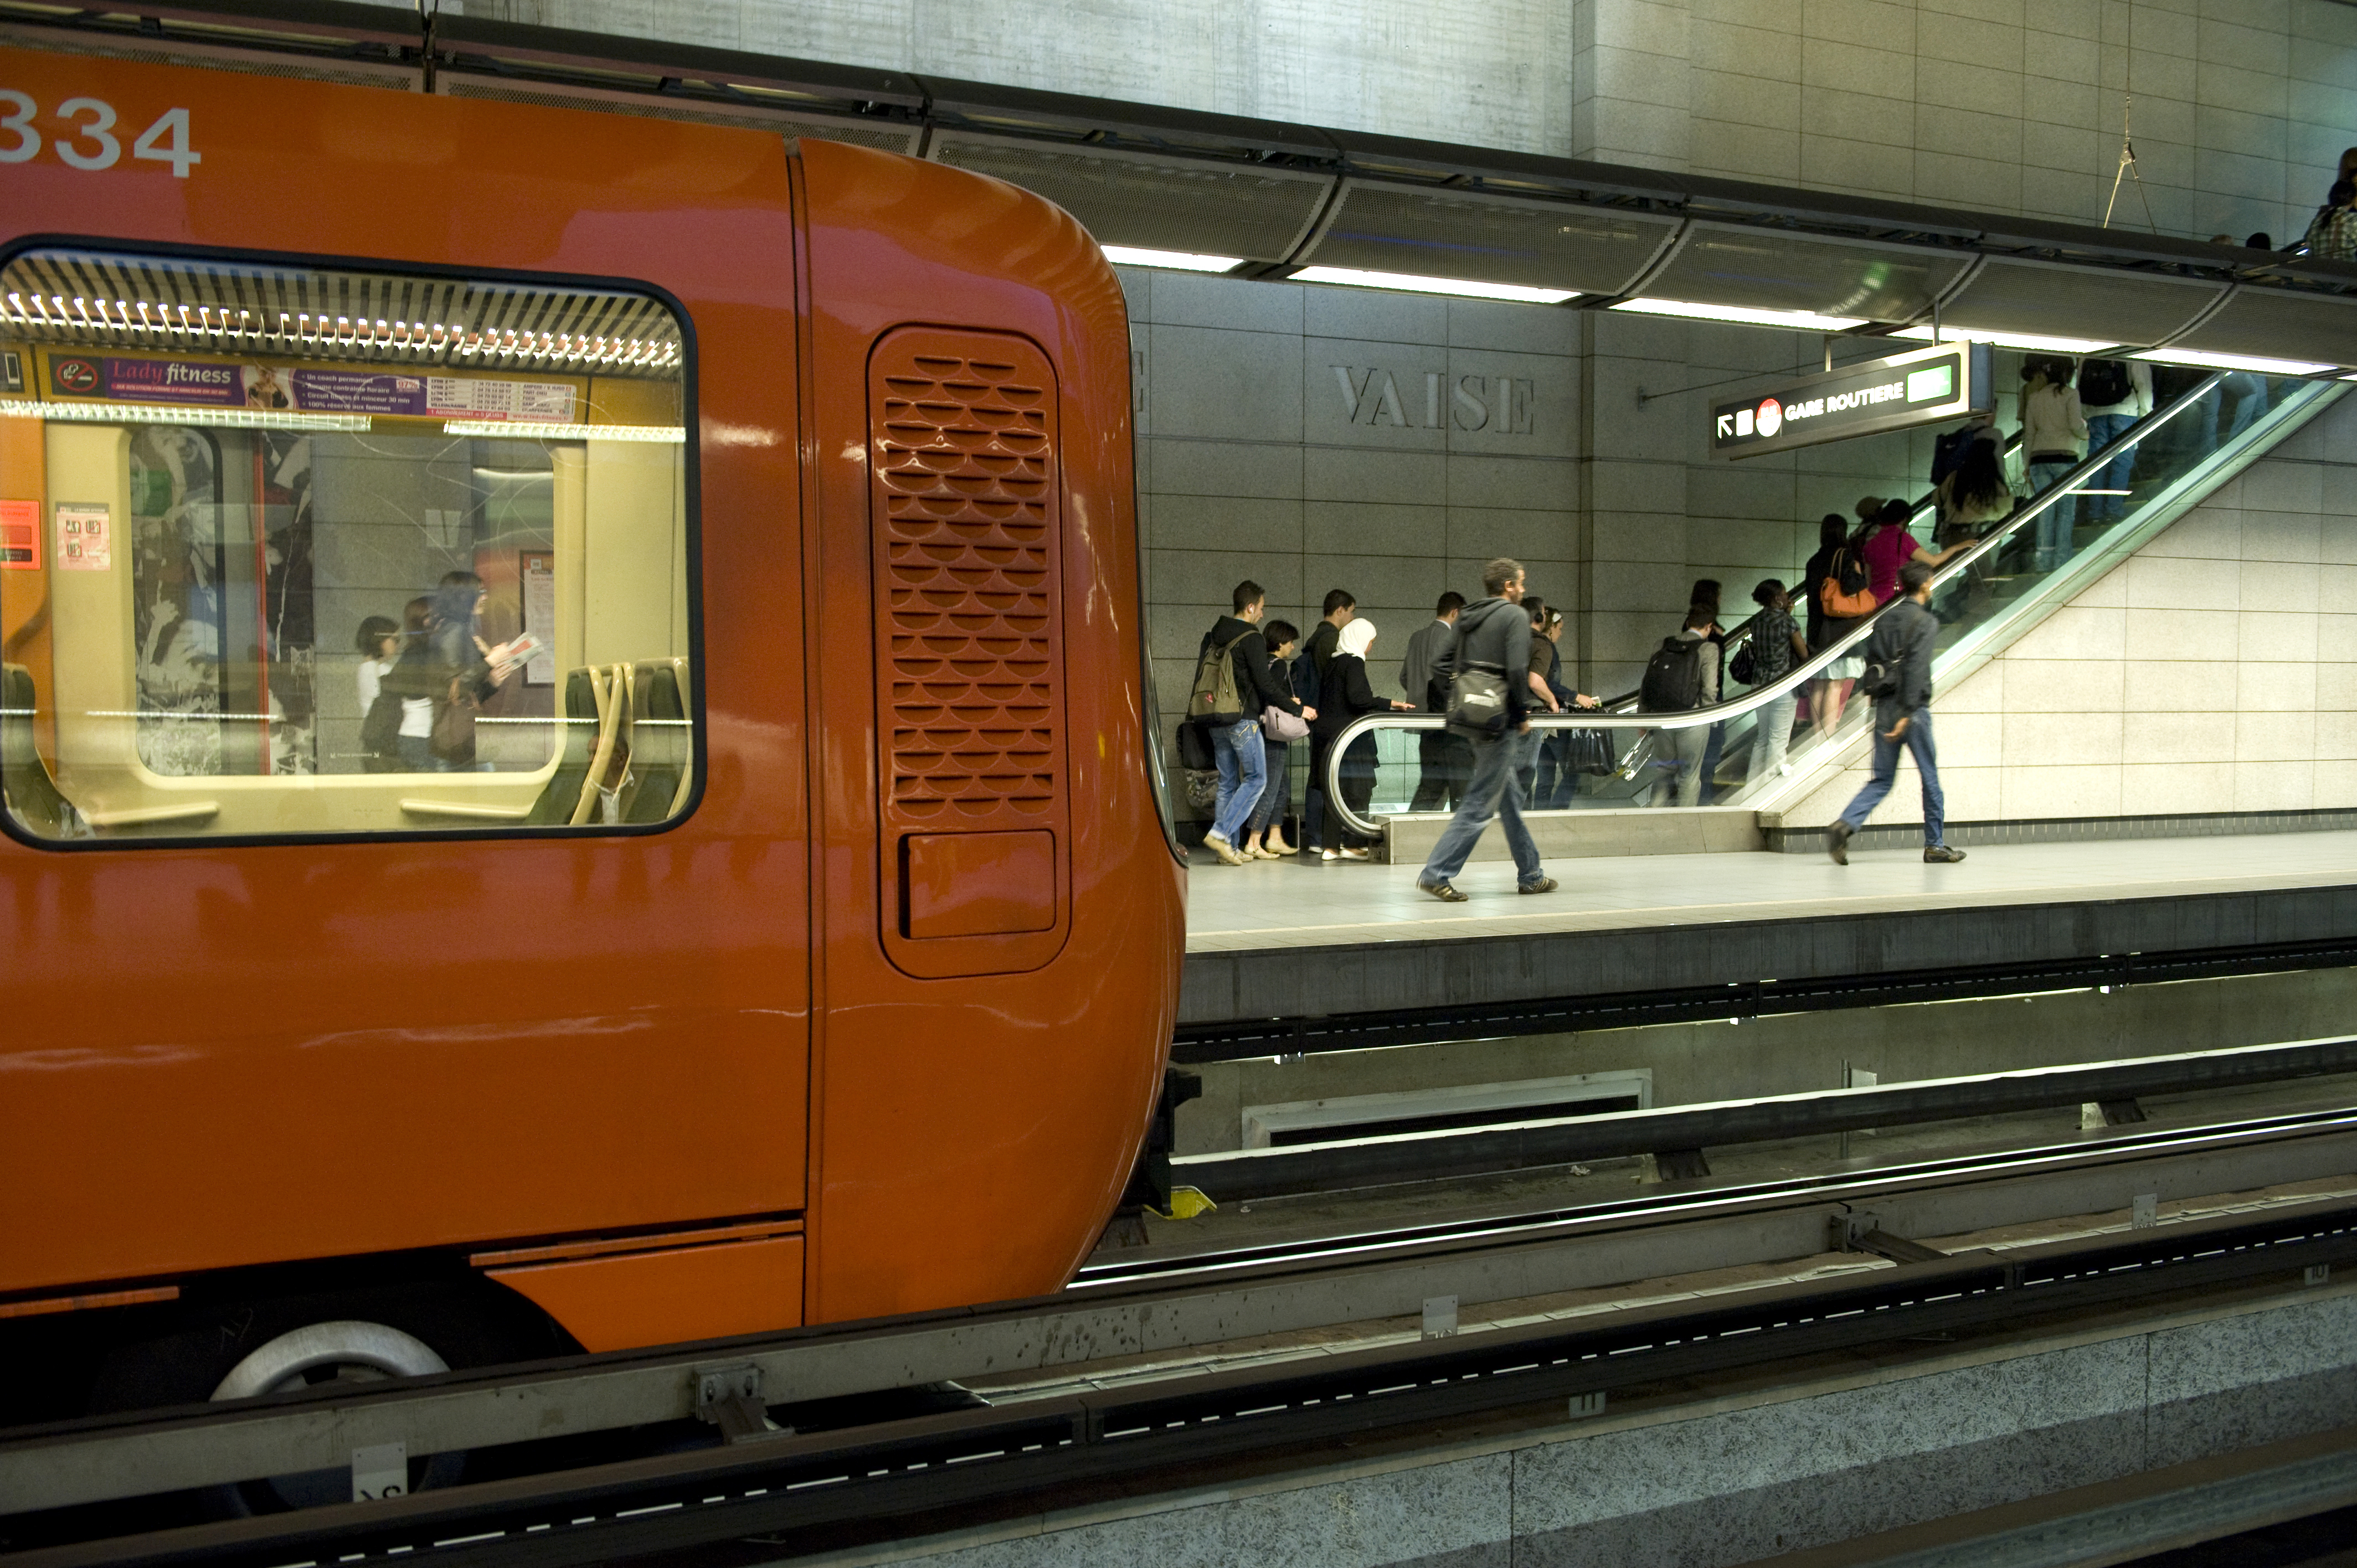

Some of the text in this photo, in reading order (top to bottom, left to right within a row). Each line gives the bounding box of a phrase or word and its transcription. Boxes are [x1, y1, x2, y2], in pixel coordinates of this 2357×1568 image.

[113, 360, 231, 385] Lady fitness
[398, 380, 418, 389] 97%
[1328, 364, 1535, 436] VAISE
[1784, 398, 1824, 421] GARE
[1826, 381, 1904, 413] ROUTIERE
